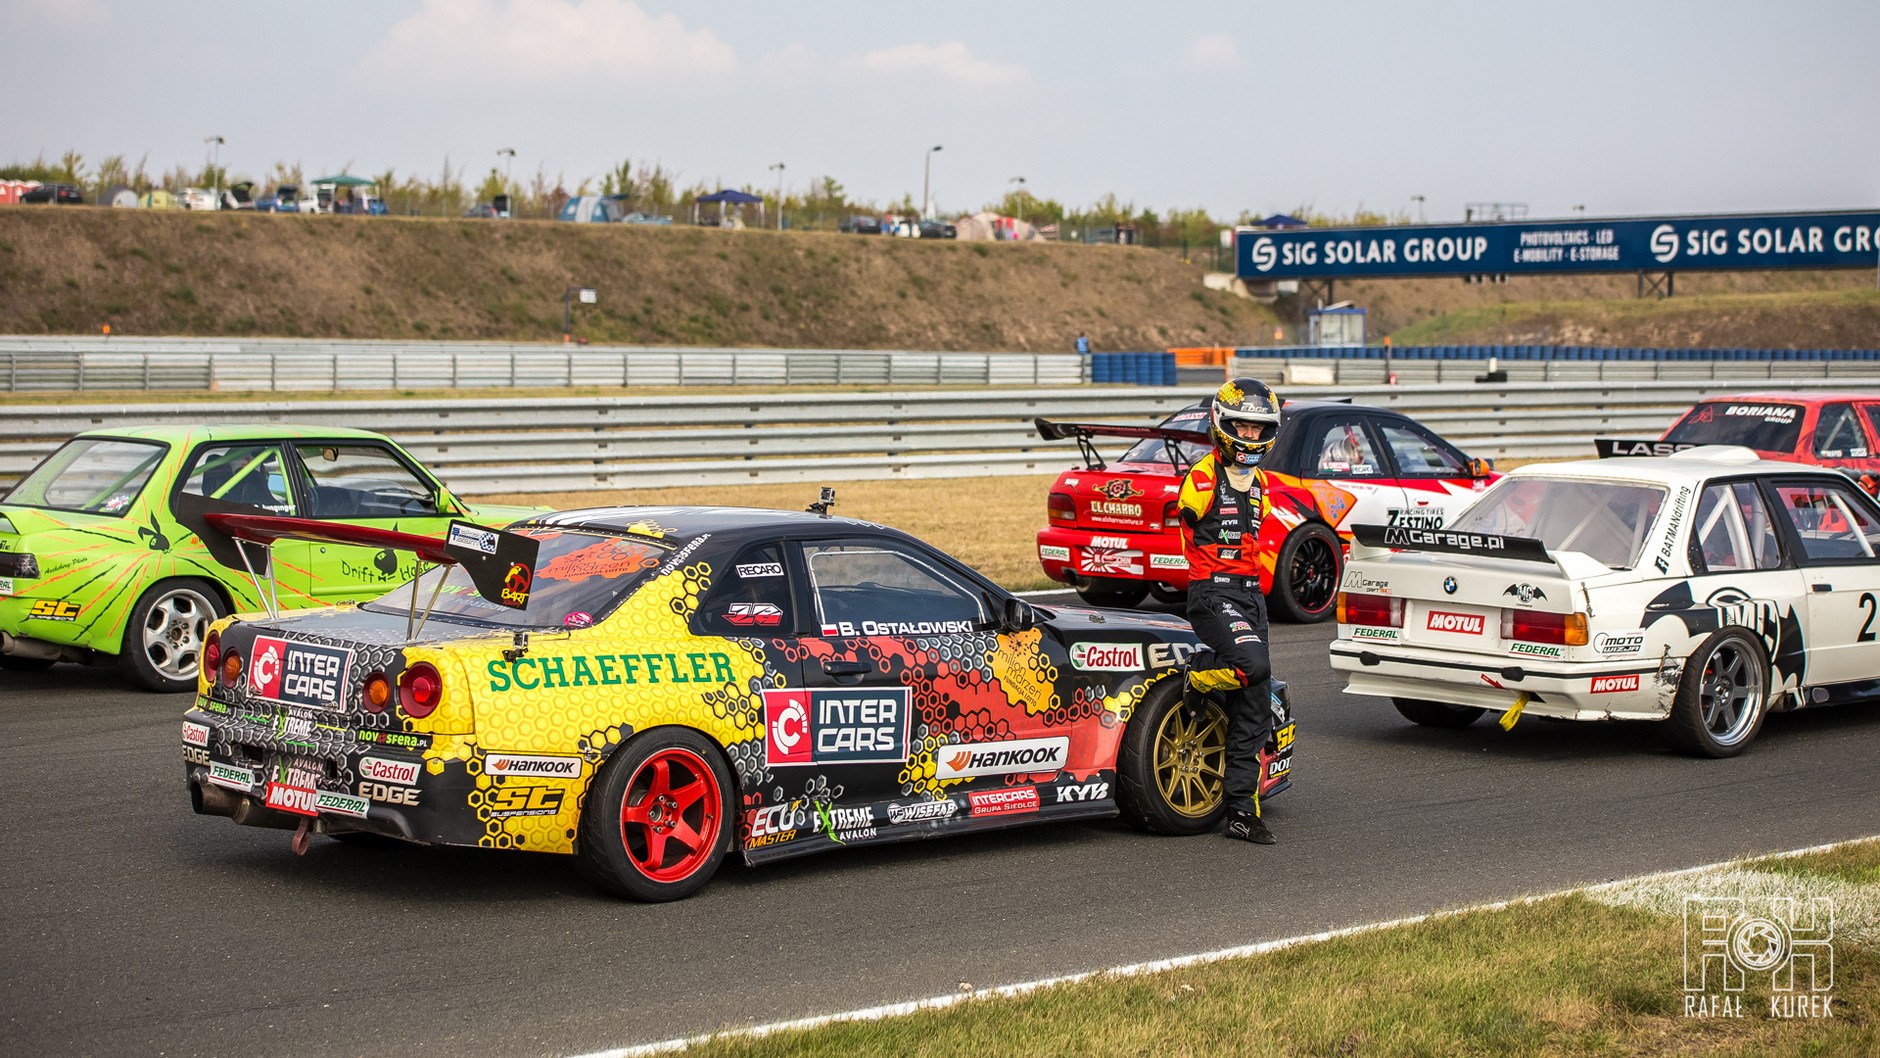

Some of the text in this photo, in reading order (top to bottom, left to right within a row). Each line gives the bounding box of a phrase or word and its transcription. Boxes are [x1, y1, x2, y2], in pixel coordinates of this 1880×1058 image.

[1596, 229, 1614, 244] LED
[1737, 226, 1823, 254] SOLAR
[1324, 239, 1396, 264] SOLAR
[1404, 236, 1487, 263] GROUP
[1725, 405, 1796, 418] BORIANA
[1764, 416, 1793, 424] GROUP
[1103, 503, 1142, 516] CHARRO
[1661, 486, 1691, 558] BATMANdrifting
[1090, 536, 1129, 549] MOTUL
[1041, 547, 1068, 557] FEDERAL
[1152, 556, 1190, 565] FEDERA
[340, 559, 375, 583] Drift
[738, 564, 782, 576] RECARO
[501, 588, 530, 605] BART
[1430, 614, 1481, 633] MOTUL
[1857, 592, 1877, 642] 2
[839, 621, 860, 636] B.
[1354, 628, 1397, 638] FEDERAL
[1511, 643, 1561, 656] FEDERAL
[1605, 637, 1643, 645] MOTO
[288, 650, 340, 677] INTER
[1086, 645, 1140, 667] Castrol
[487, 652, 736, 692] SCHAEFFLER
[284, 674, 337, 700] CARS
[1593, 677, 1637, 691] MOTUL
[288, 707, 313, 718] AVALON
[819, 699, 897, 724] INTER
[187, 725, 208, 744] Castrol
[816, 727, 896, 753] CARS
[293, 758, 323, 771] AVALON
[372, 761, 416, 781] Castrol
[212, 767, 251, 784] FEDERAL
[358, 781, 422, 806] EDGE
[972, 789, 1036, 806] INTERCARS
[1056, 782, 1109, 803] KYB
[317, 794, 366, 813] FEDERAL
[905, 803, 954, 819] WISEFAB
[974, 801, 1037, 814] GRUPA SIEDLCE
[751, 801, 797, 838] ECU
[749, 829, 797, 849] MASTER
[839, 827, 877, 840] AVALON
